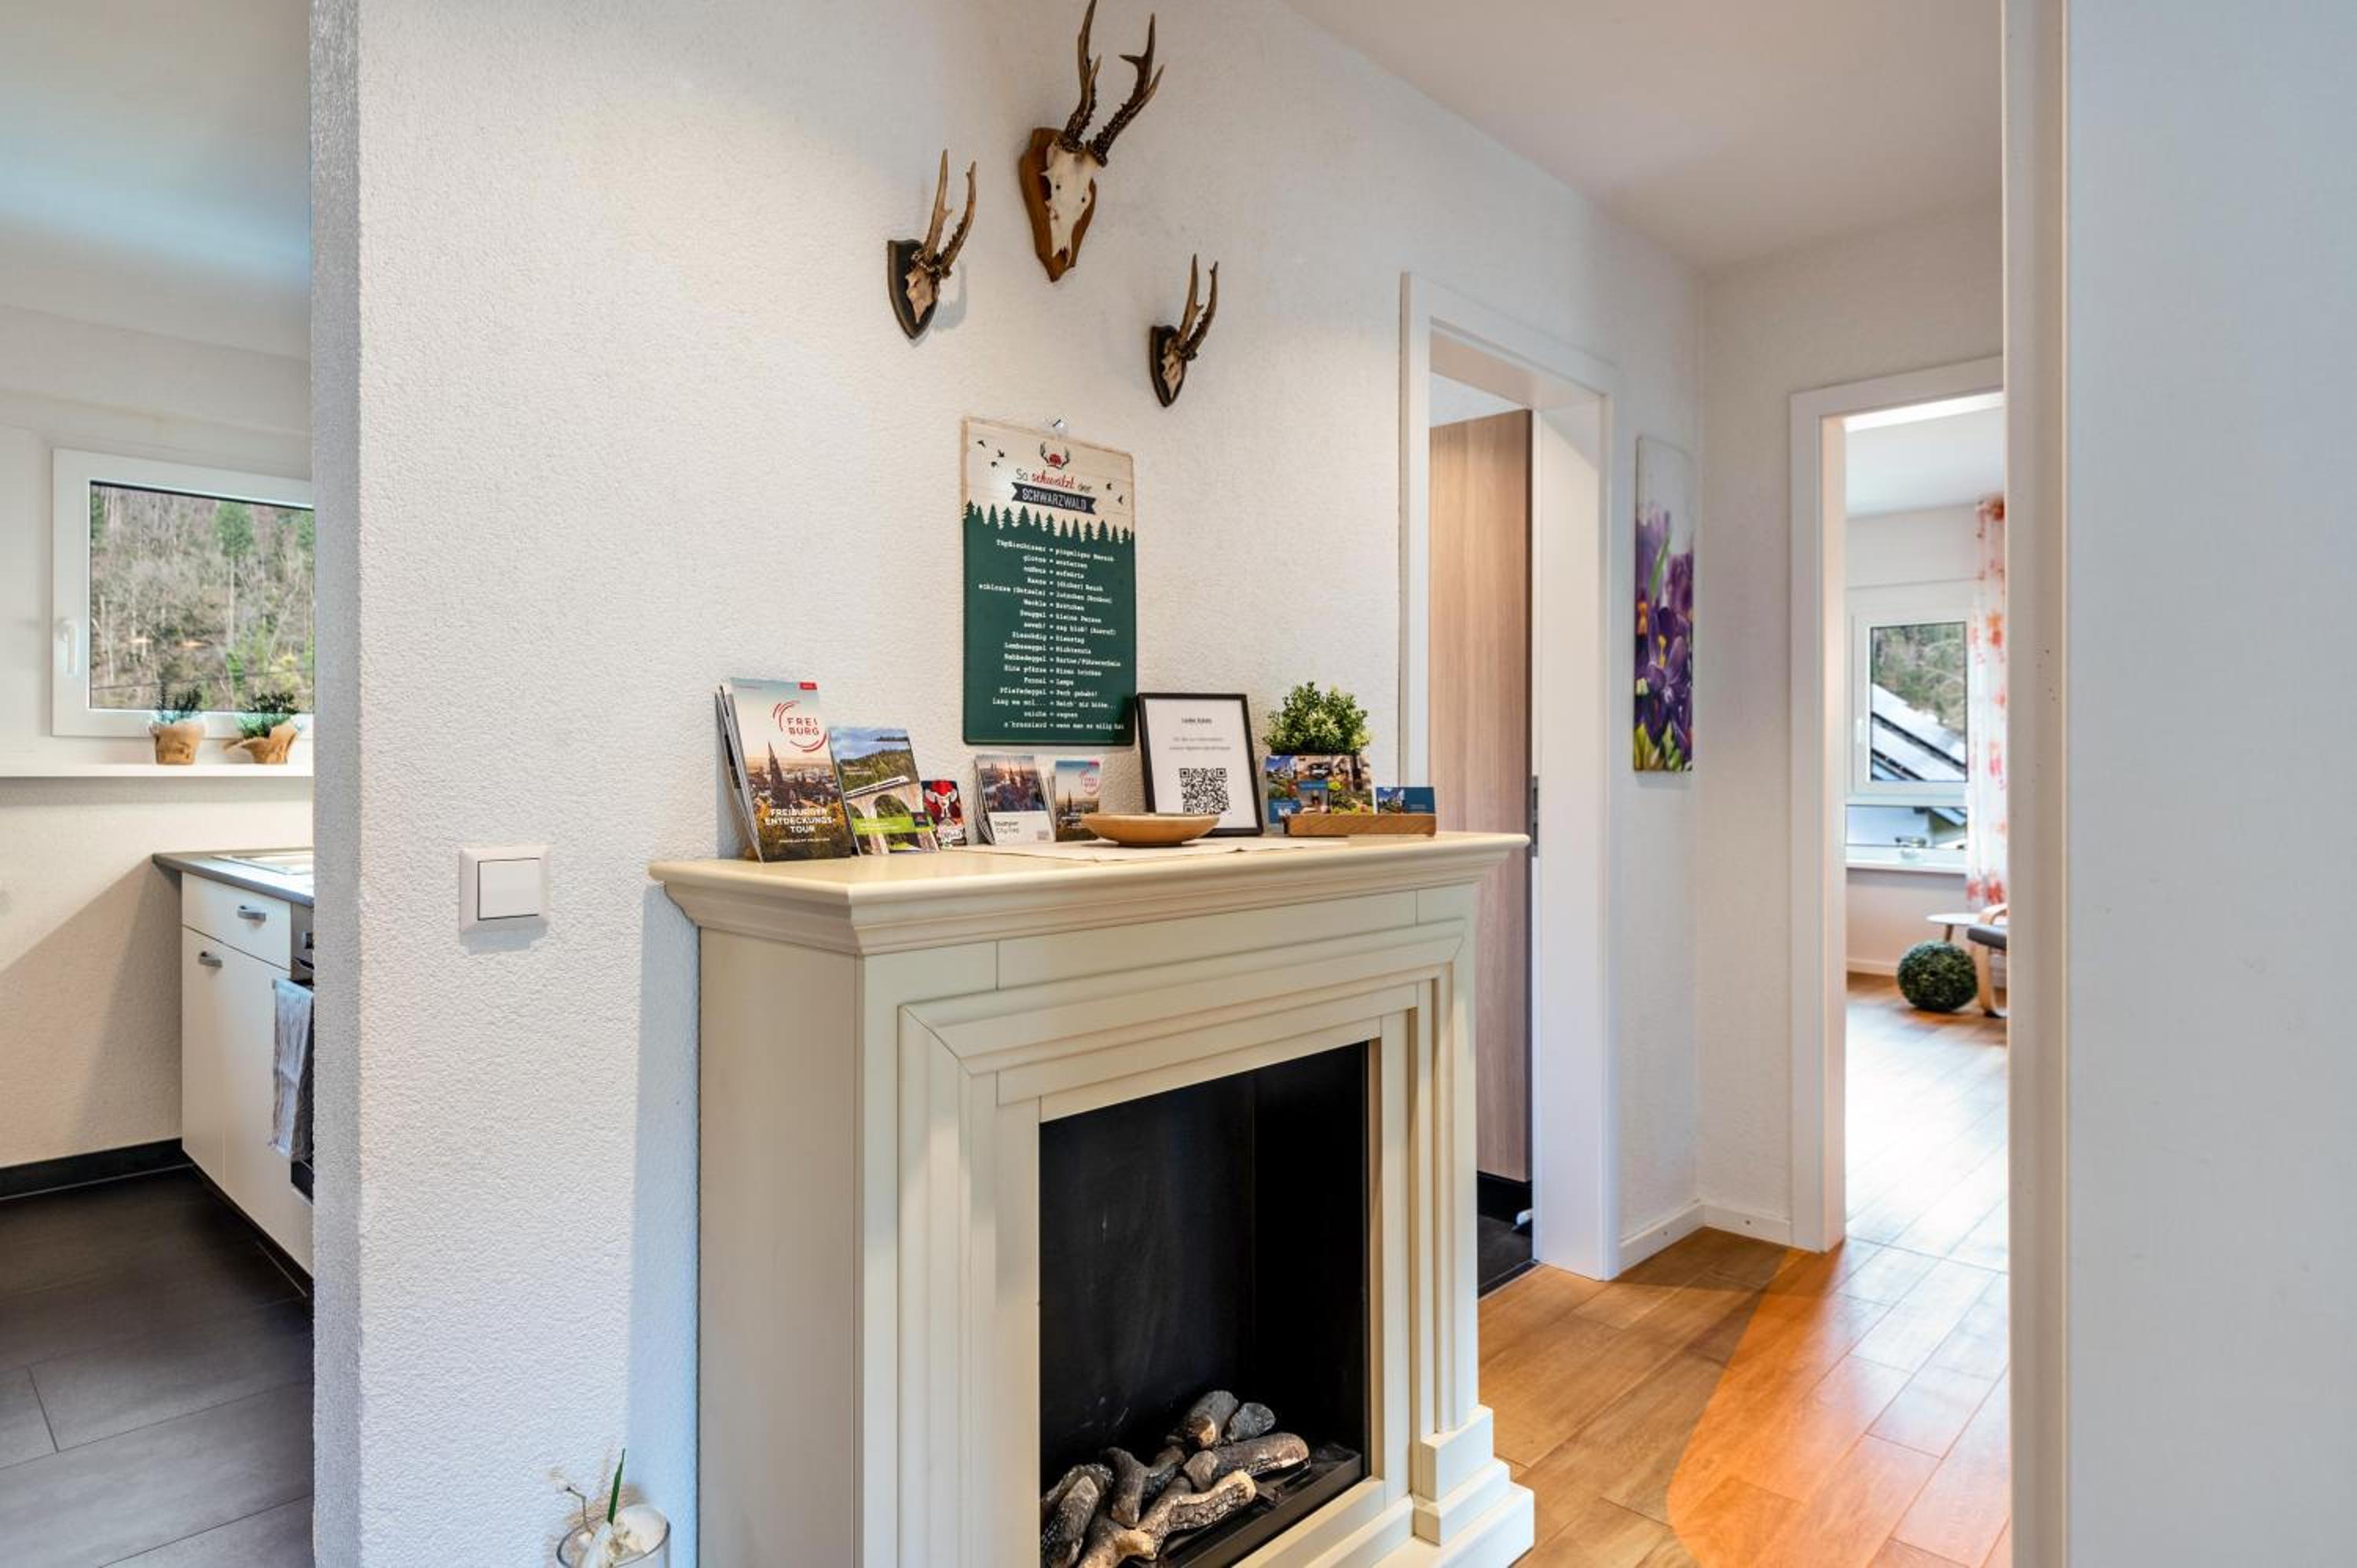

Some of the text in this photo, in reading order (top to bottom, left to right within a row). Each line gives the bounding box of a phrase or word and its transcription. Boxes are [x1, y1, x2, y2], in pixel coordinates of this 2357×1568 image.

[1016, 468, 1028, 481] So
[1077, 482, 1092, 492] der
[1022, 488, 1087, 511] SCHWARZWALD
[1056, 635, 1085, 644] Dienstag
[786, 717, 818, 726] FREI
[788, 727, 819, 736] BURG
[771, 808, 827, 816] FREIBURGER
